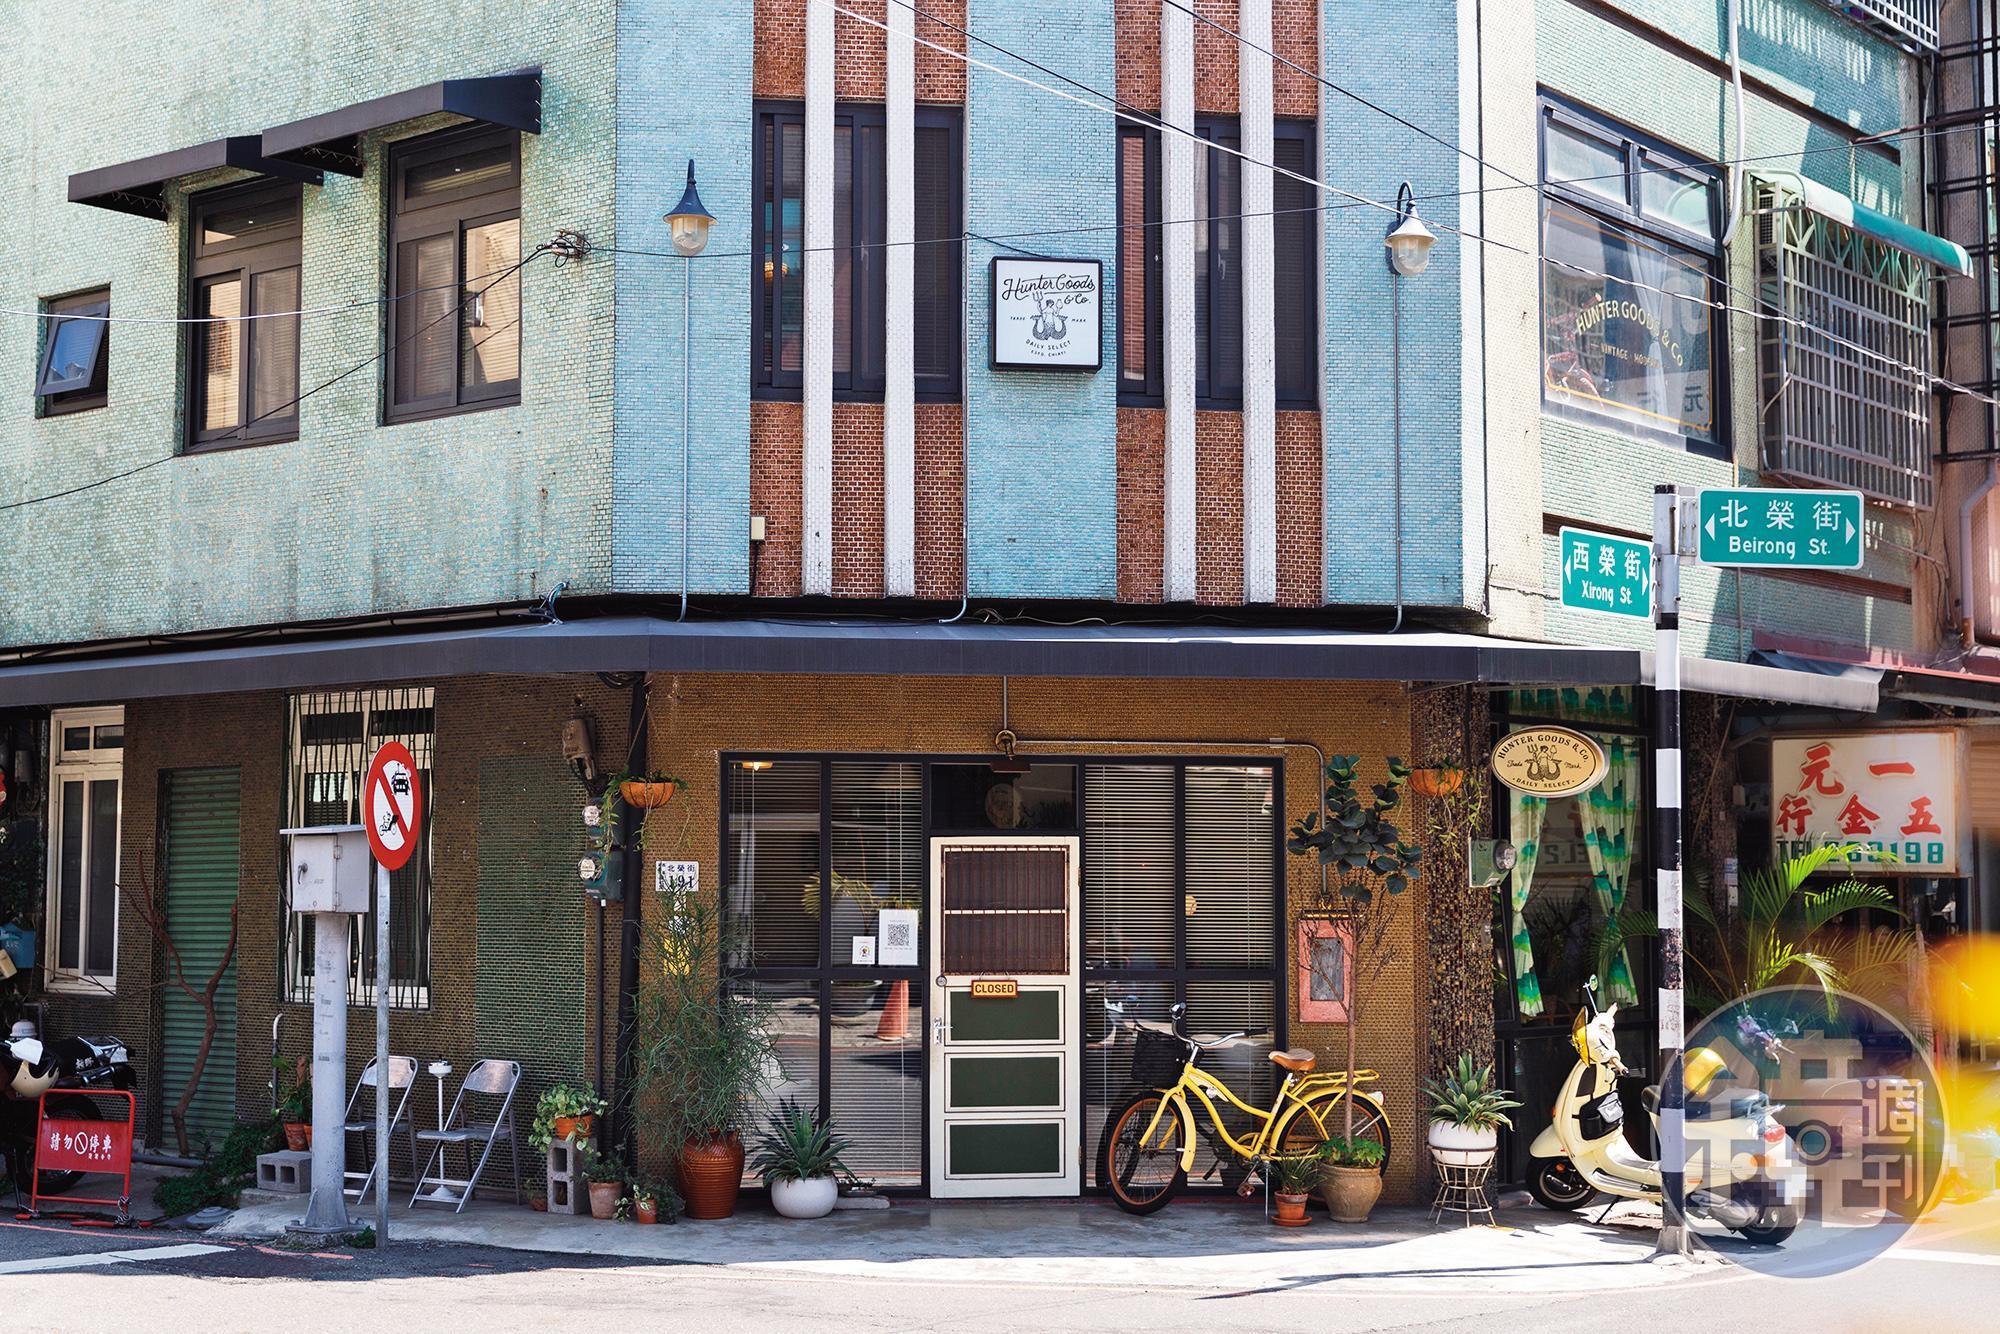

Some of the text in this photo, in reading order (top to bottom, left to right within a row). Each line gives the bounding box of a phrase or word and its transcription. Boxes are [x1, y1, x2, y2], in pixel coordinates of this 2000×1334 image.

[1002, 273, 1096, 300] Hunter Goods
[1064, 295, 1075, 304] &
[1575, 300, 1620, 336] HUNTER
[1621, 301, 1660, 336] GOODS
[1661, 329, 1670, 348] &
[1025, 338, 1071, 350] DAILY SELECT
[1600, 342, 1629, 361] VINTAGE
[1719, 499, 1842, 531] 北榮街
[1729, 536, 1831, 559] Beirong St.
[1572, 540, 1641, 581] 西榮街
[1581, 580, 1614, 608] Xirong
[1498, 735, 1534, 759] HUNTER
[1537, 734, 1571, 746] GOODS
[1572, 743, 1579, 753] &
[1516, 778, 1571, 788] DAILY SELECT
[667, 864, 695, 873] 北榮街
[669, 875, 694, 889] 191
[974, 984, 1015, 994] CLOSED
